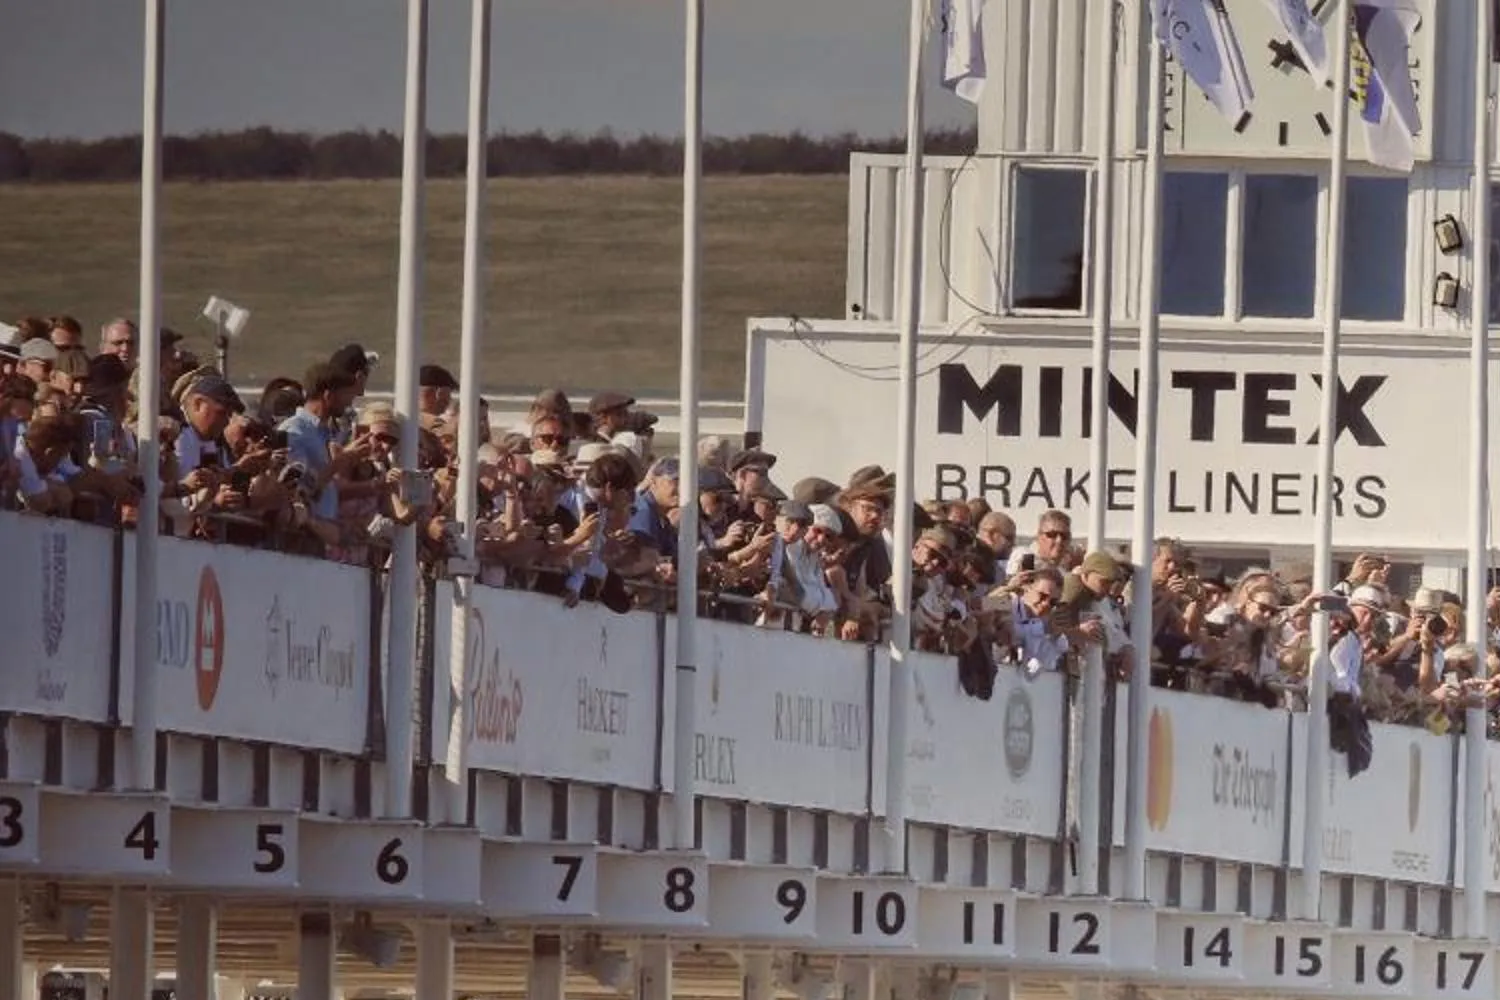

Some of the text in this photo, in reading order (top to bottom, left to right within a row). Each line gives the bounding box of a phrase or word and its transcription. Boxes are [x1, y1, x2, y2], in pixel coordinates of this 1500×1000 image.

[935, 363, 1389, 447] MINTEX
[935, 464, 1388, 519] BRAKE LINERS
[0, 797, 23, 847] 3
[125, 812, 158, 860] 4
[254, 825, 285, 873] 5
[376, 838, 408, 884] 6
[553, 856, 583, 901] 7
[664, 867, 695, 912] 8
[776, 879, 807, 924] 9
[853, 891, 906, 935] 10
[964, 902, 1004, 944] 11
[1050, 912, 1099, 954] 12
[1184, 926, 1232, 967] 14
[1275, 936, 1322, 977] 15
[1355, 945, 1404, 985] 16
[1437, 951, 1485, 990] 17
